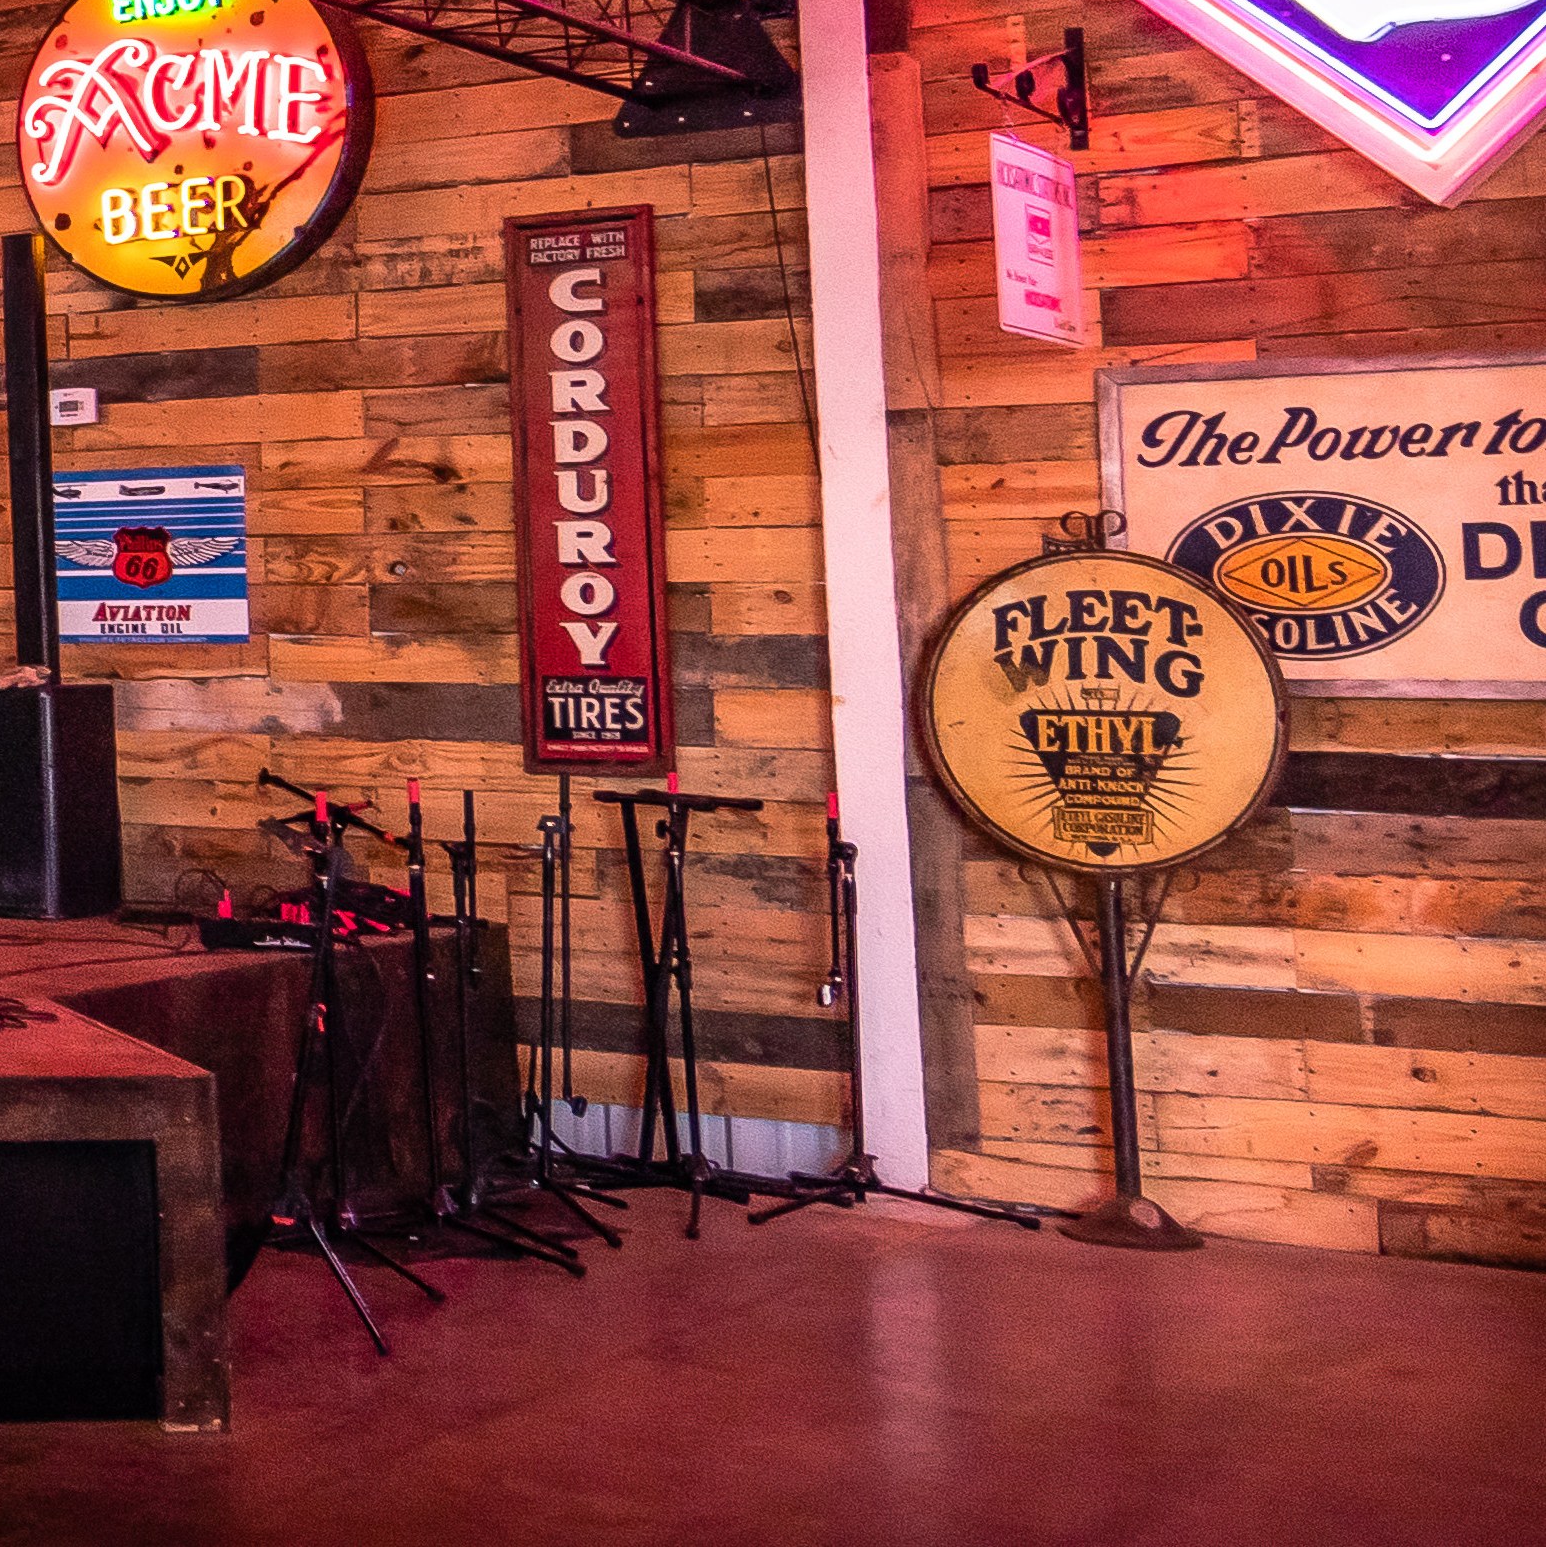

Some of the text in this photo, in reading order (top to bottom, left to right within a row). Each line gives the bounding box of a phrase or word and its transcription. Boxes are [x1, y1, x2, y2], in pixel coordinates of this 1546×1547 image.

[24, 38, 328, 184] ACME
[99, 175, 248, 245] BEER
[529, 230, 625, 250] REPLACE WITH
[530, 244, 626, 264] FACTORY FRESH
[1136, 409, 1261, 468] The
[1257, 405, 1484, 465] Power
[547, 267, 620, 667] CORDUROY
[1495, 469, 1546, 507] th
[1203, 498, 1407, 553] DIXIE
[125, 554, 159, 581] 66
[1260, 554, 1350, 596] OILS
[92, 602, 192, 622] AVIATION
[99, 622, 183, 635] ENGINE OIL
[991, 589, 1204, 652] FLEET-
[1250, 585, 1418, 652] SOLINE
[993, 637, 1206, 699] WING
[547, 696, 645, 730] TIRES
[1035, 714, 1158, 755] ETHYL
[1064, 765, 1139, 778] BRAND OF
